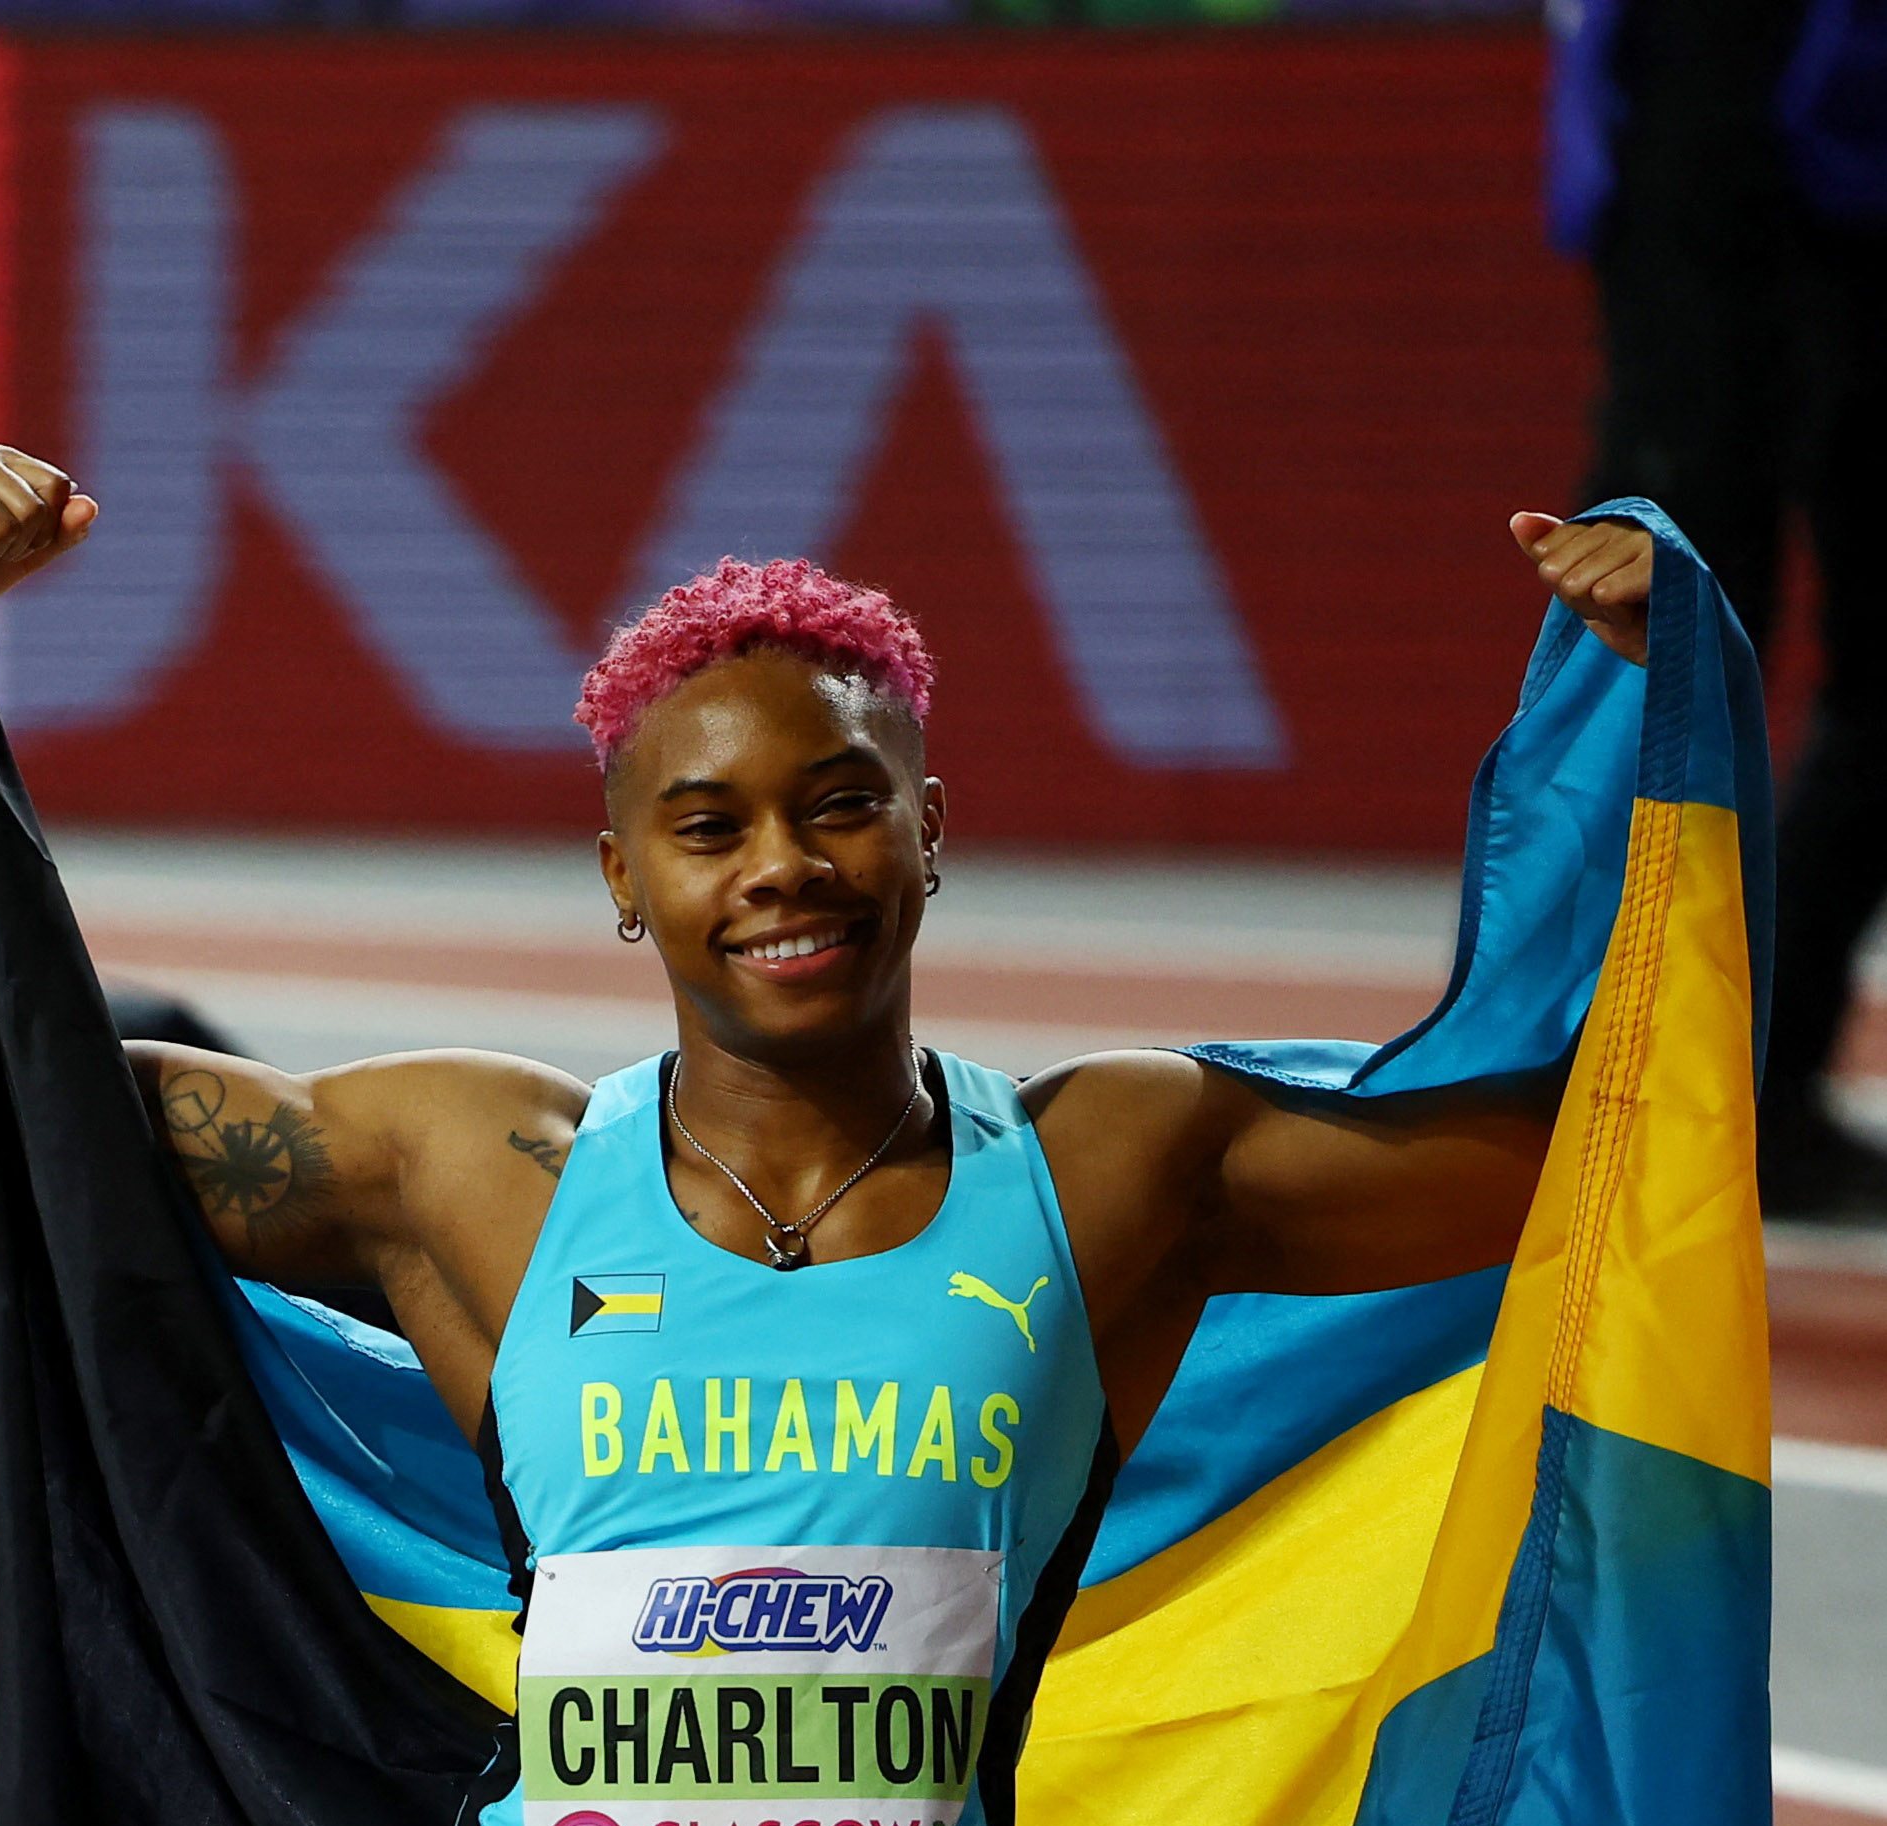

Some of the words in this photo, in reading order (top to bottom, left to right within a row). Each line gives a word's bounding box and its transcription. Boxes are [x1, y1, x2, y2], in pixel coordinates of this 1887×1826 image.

[580, 1377, 1020, 1490] BAHAMAS
[632, 1576, 894, 1653] HI-CHEW
[547, 1685, 974, 1787] CHARLTON
